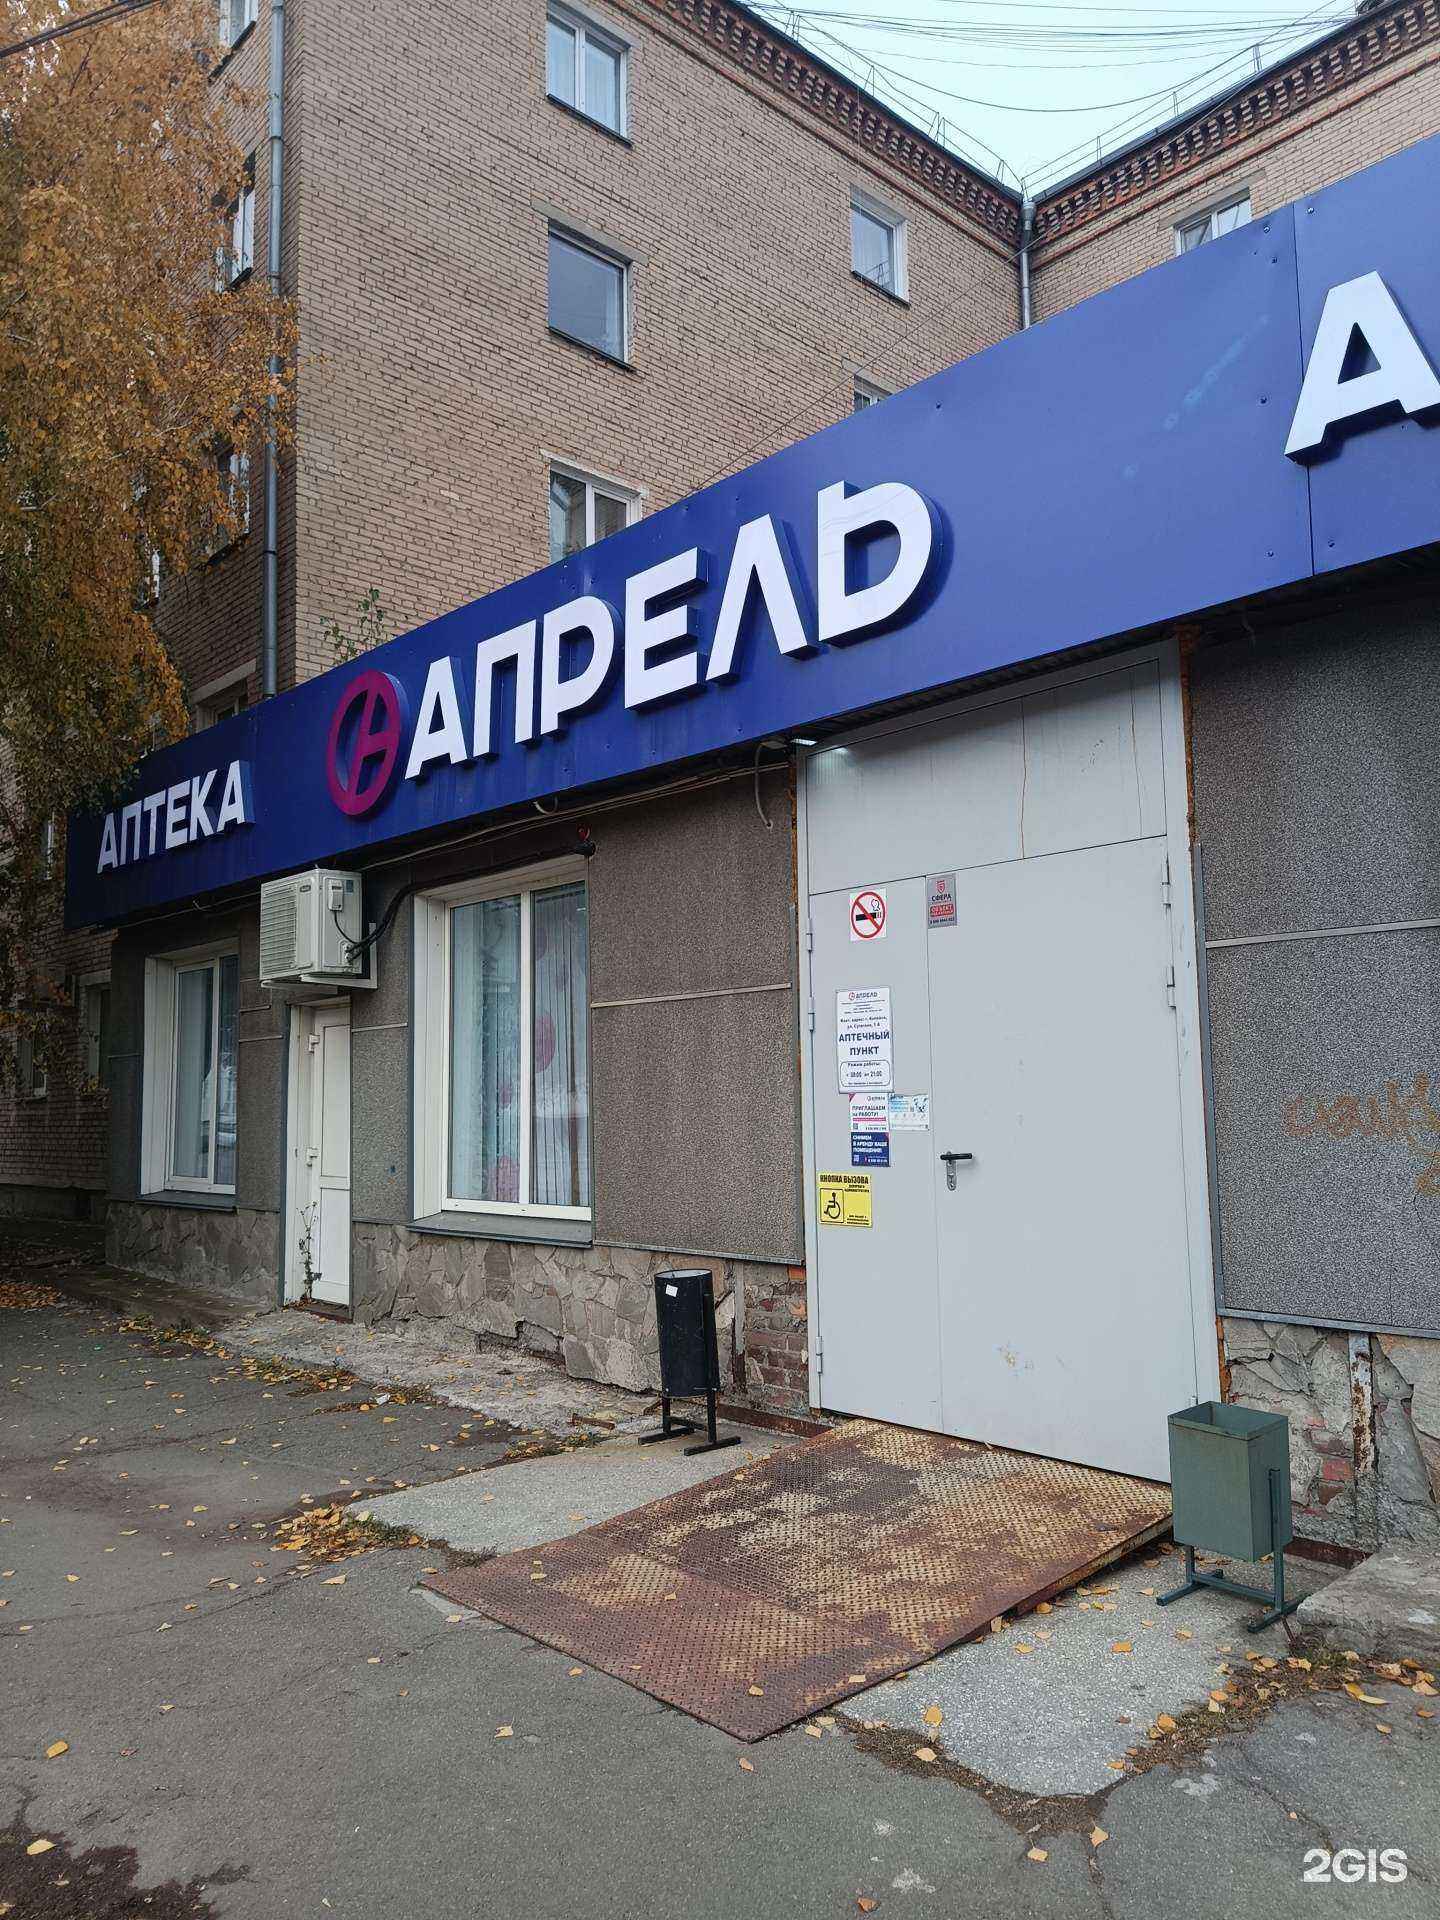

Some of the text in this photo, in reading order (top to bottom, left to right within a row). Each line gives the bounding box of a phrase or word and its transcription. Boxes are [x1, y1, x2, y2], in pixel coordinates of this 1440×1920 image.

[404, 480, 932, 780] АПРЕЛЬ
[97, 759, 249, 874] АПТЕКА
[839, 1029, 890, 1042] АПТЕЧНЫЙ
[850, 1045, 879, 1056] ПУНКТ
[843, 1175, 869, 1184] ВЫЗОВА
